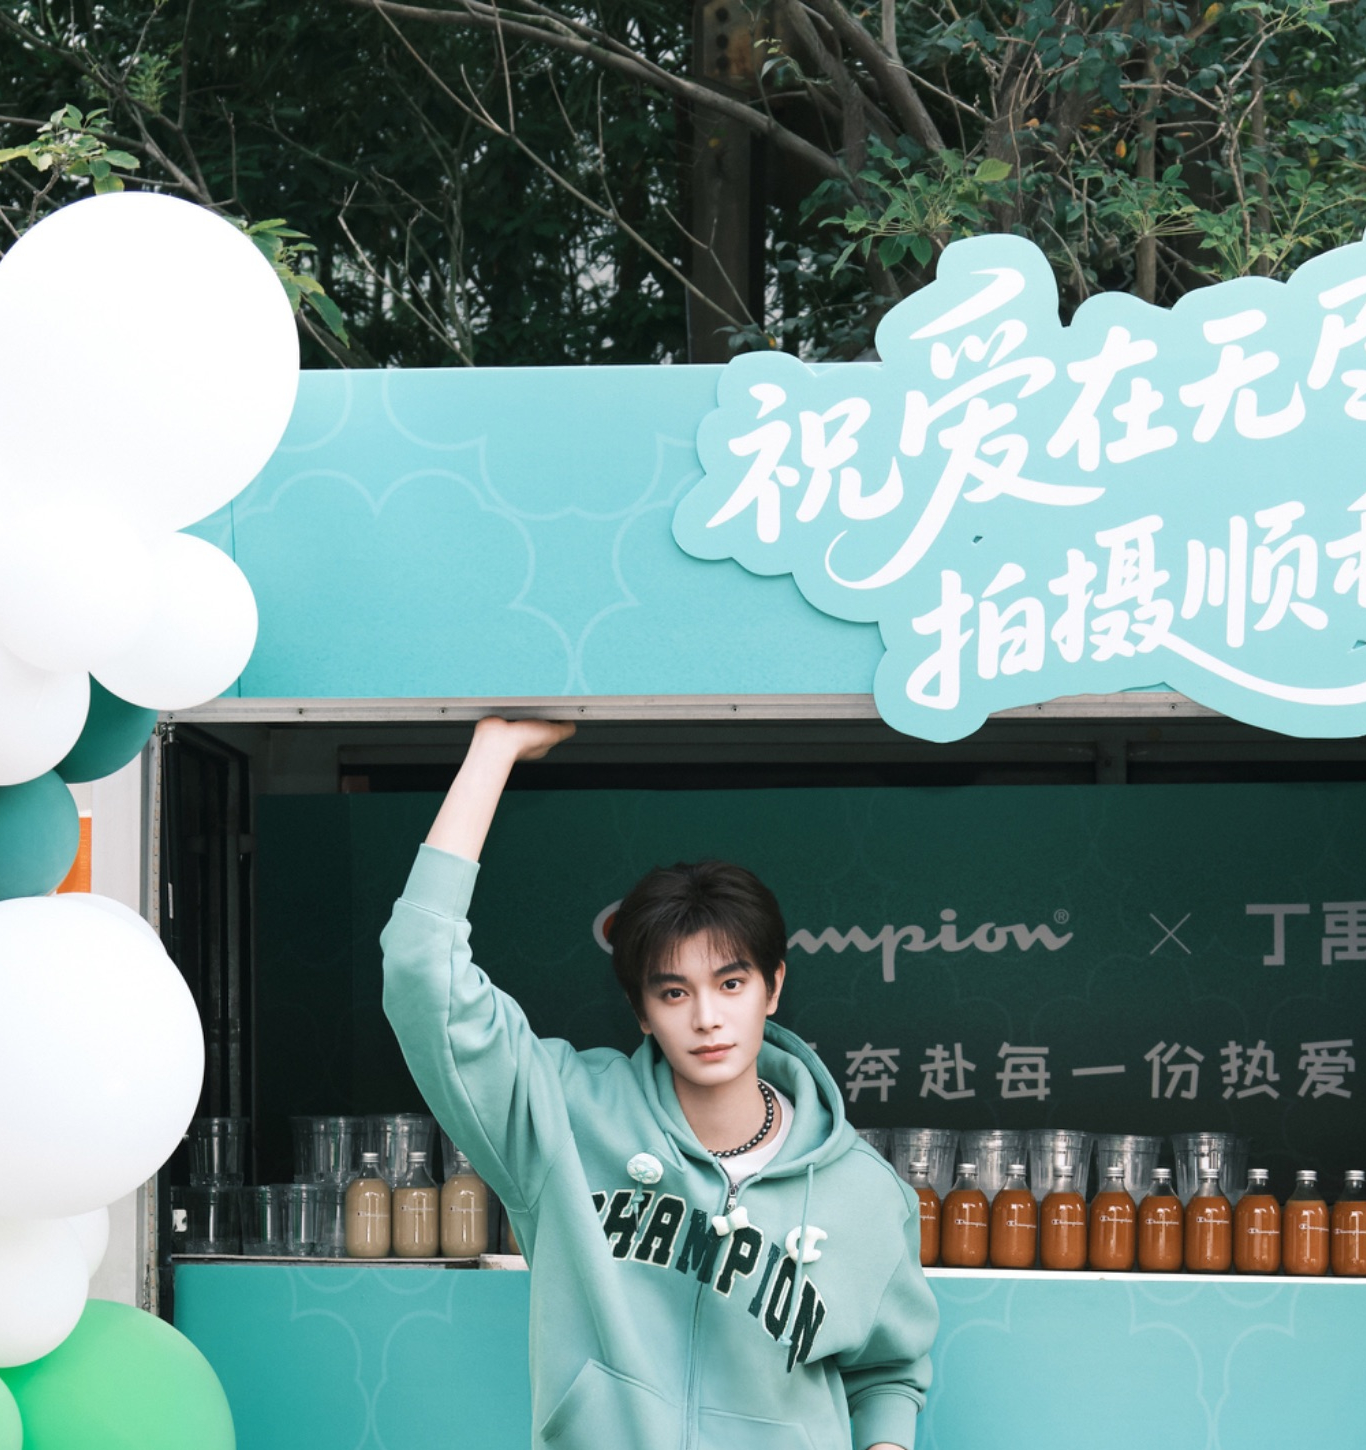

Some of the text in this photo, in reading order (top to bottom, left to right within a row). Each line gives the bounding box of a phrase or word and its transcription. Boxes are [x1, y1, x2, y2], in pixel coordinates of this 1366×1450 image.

[807, 1037, 1357, 1104] 奔赴每一份热爱
[581, 1189, 828, 1374] HAMPION
